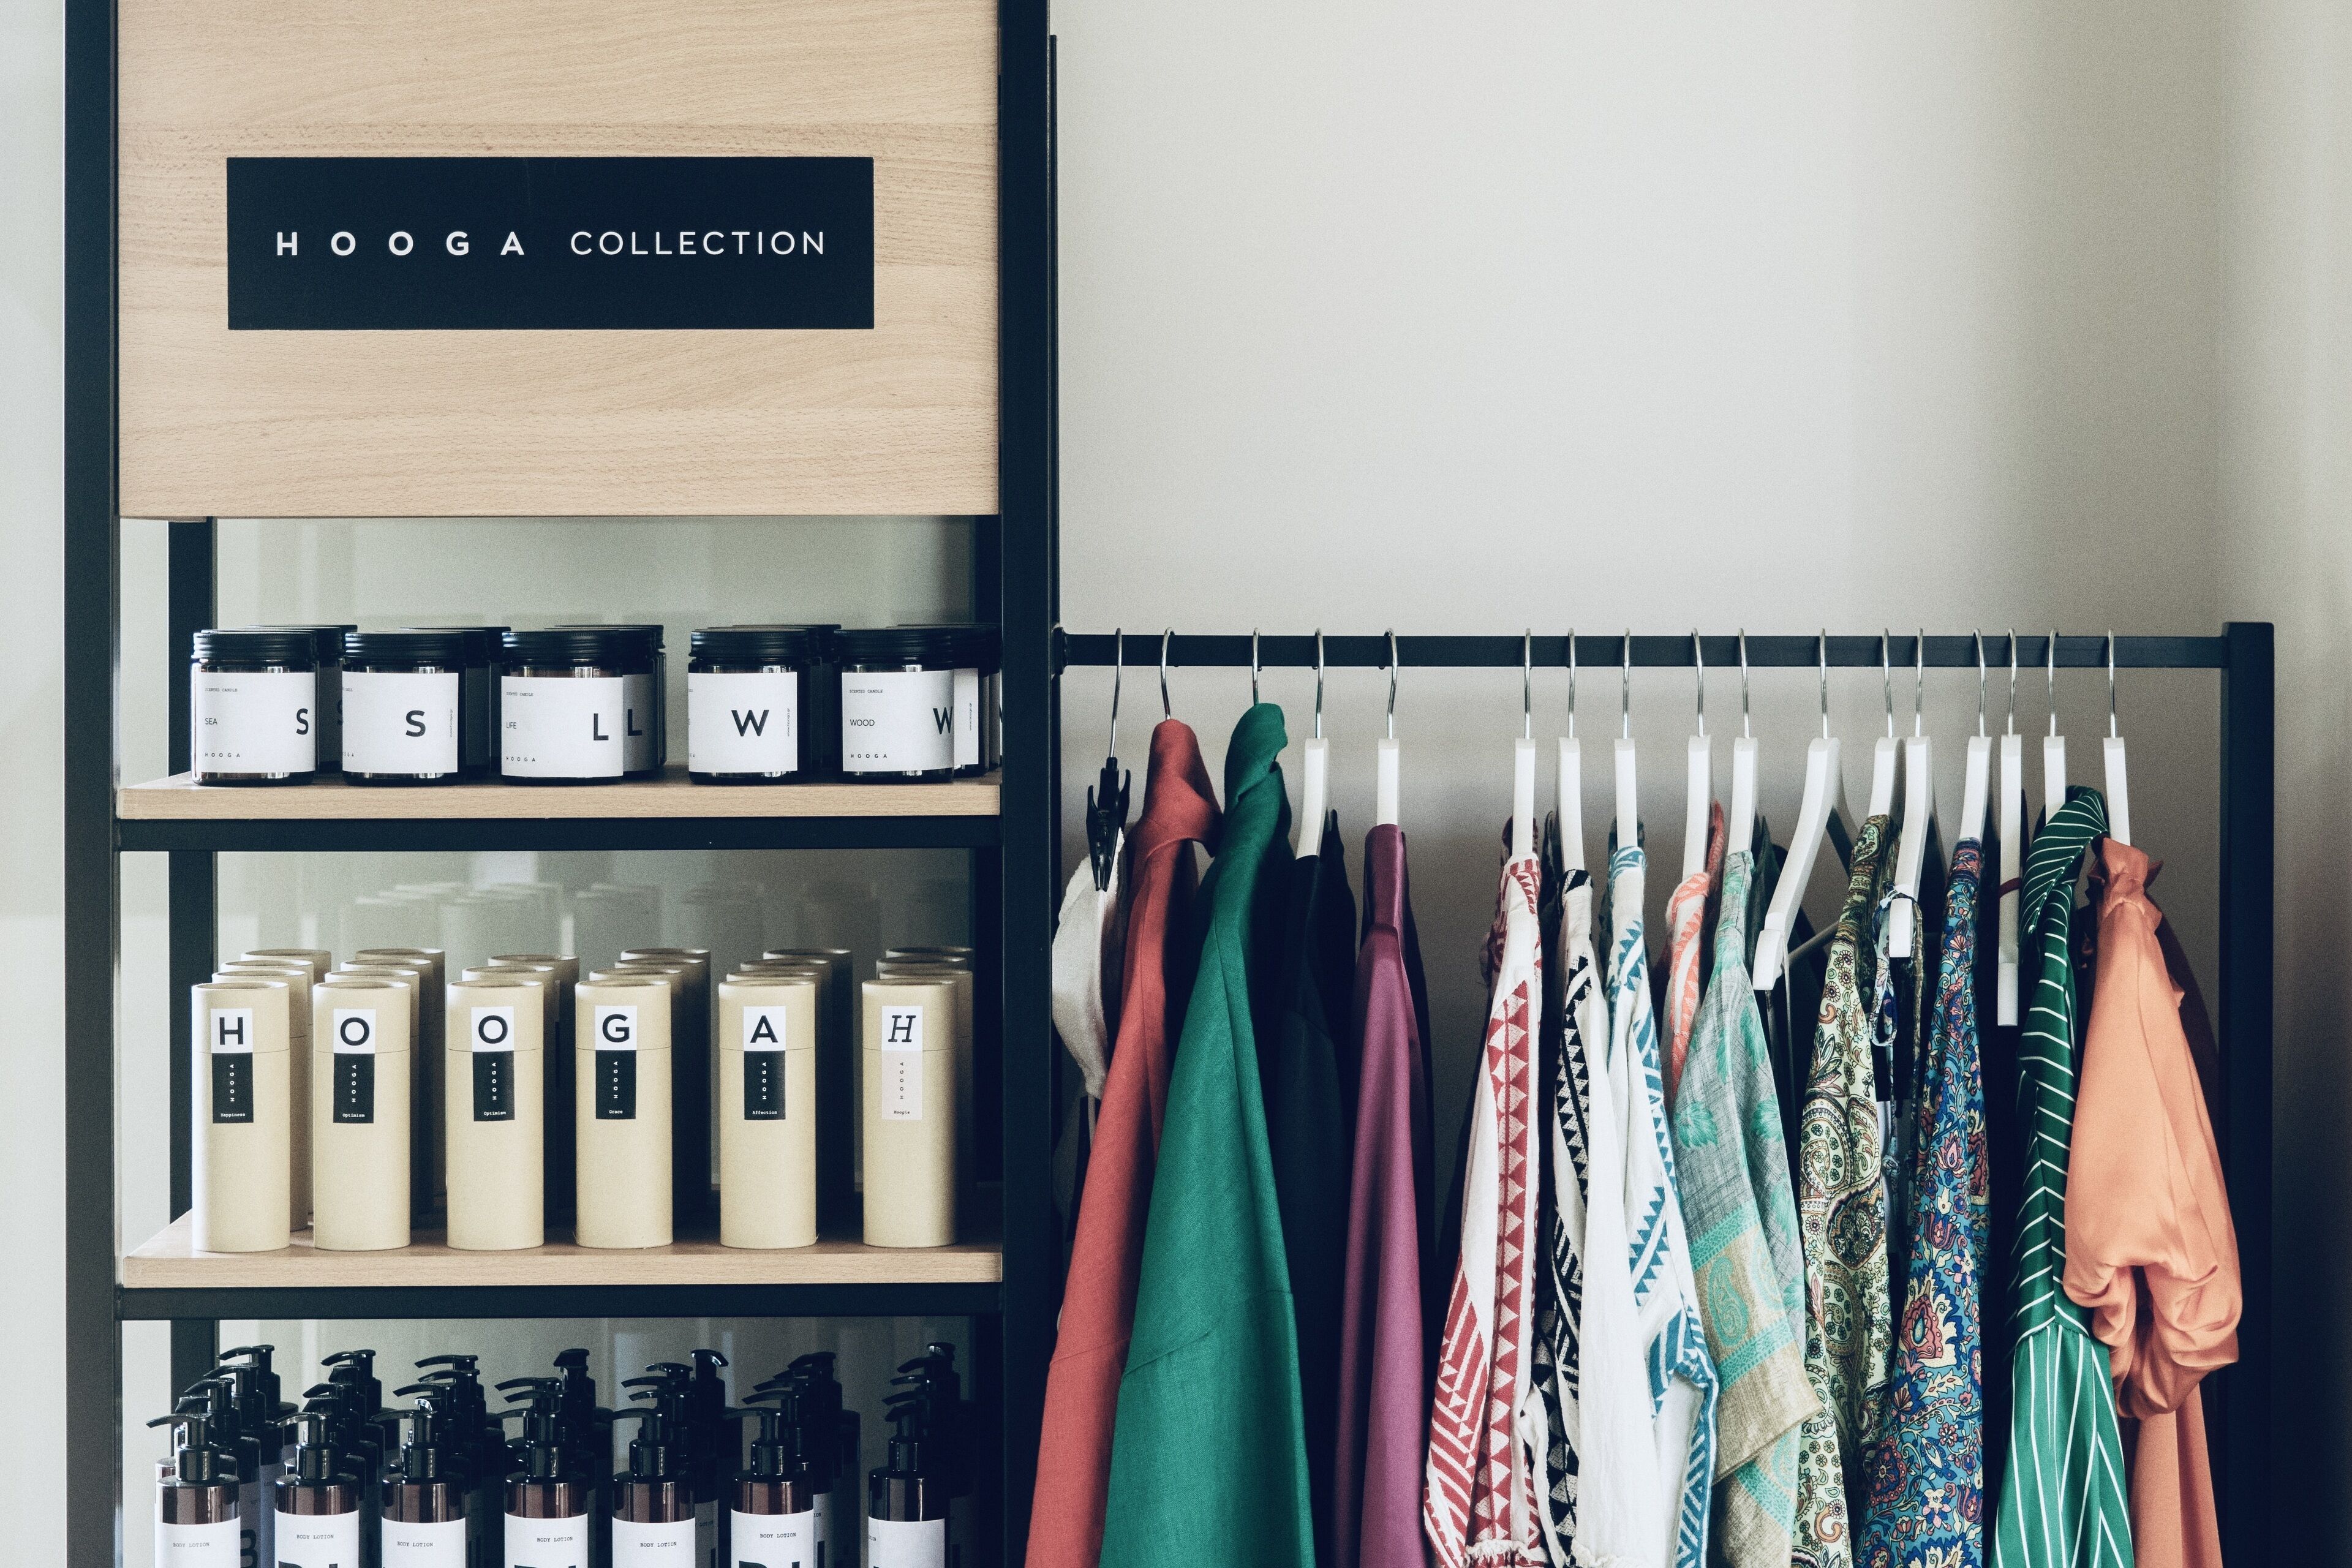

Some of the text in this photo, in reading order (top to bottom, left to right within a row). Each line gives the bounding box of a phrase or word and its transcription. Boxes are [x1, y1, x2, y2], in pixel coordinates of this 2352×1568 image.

[276, 230, 824, 257] HOOGA COLLECTION
[296, 708, 309, 736] S
[405, 710, 427, 737] S
[593, 713, 609, 741] L
[627, 709, 643, 736] L
[731, 709, 770, 737] W
[932, 706, 953, 735] W
[219, 1017, 244, 1046] H
[340, 1017, 370, 1046] O
[478, 1014, 508, 1044] O
[601, 1014, 630, 1043] G
[750, 1014, 779, 1044] A
[888, 1014, 917, 1043] H
